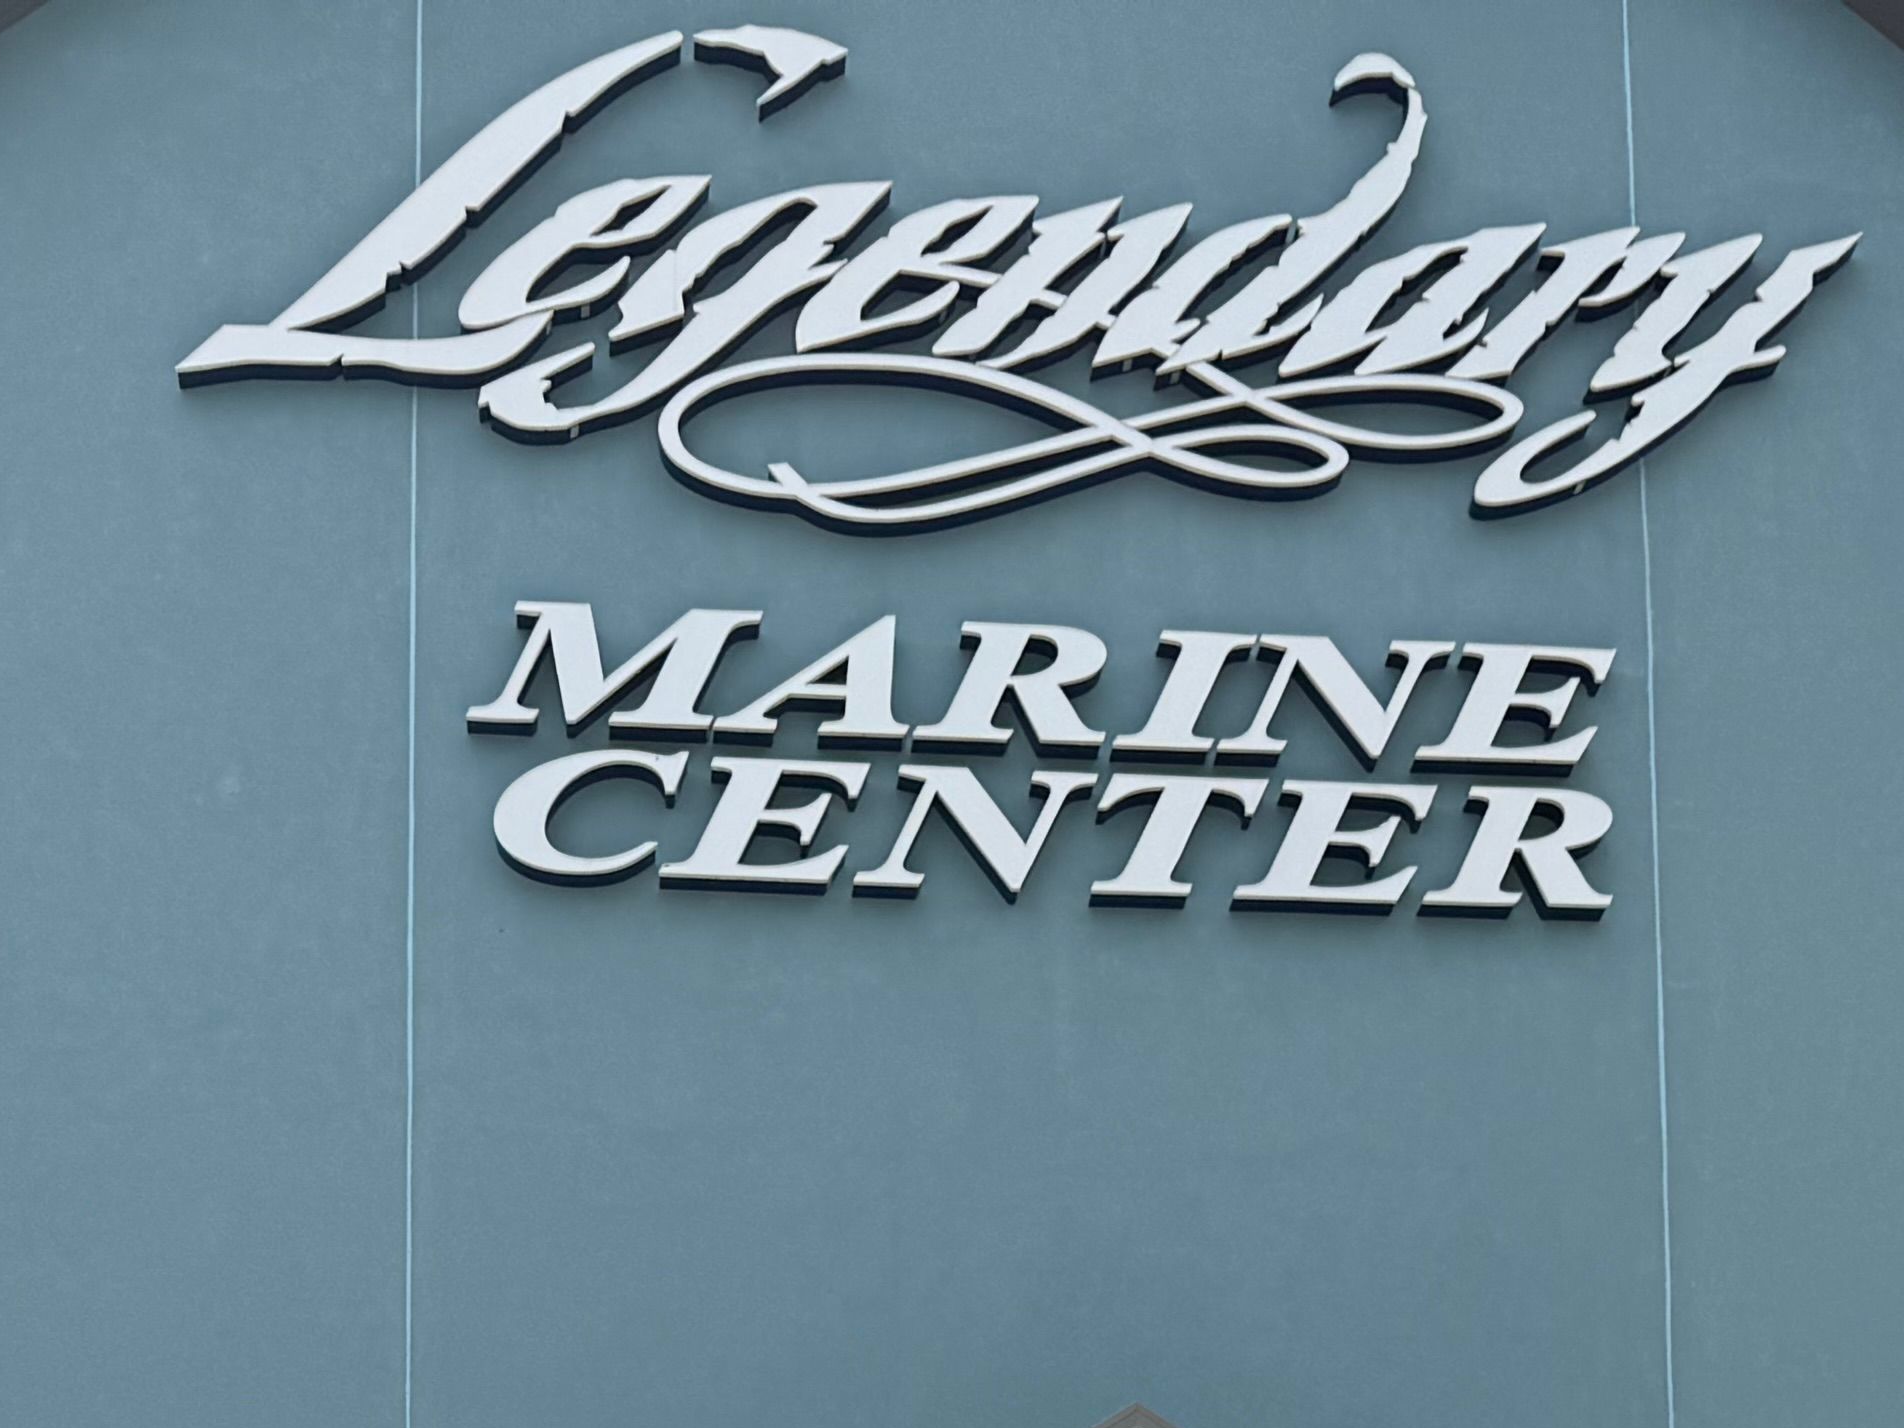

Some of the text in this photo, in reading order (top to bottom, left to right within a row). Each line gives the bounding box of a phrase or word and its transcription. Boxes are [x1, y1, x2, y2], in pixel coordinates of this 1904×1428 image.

[176, 22, 1863, 536] Legendary
[466, 600, 1616, 776] MARINE
[492, 749, 1615, 918] CENTER
